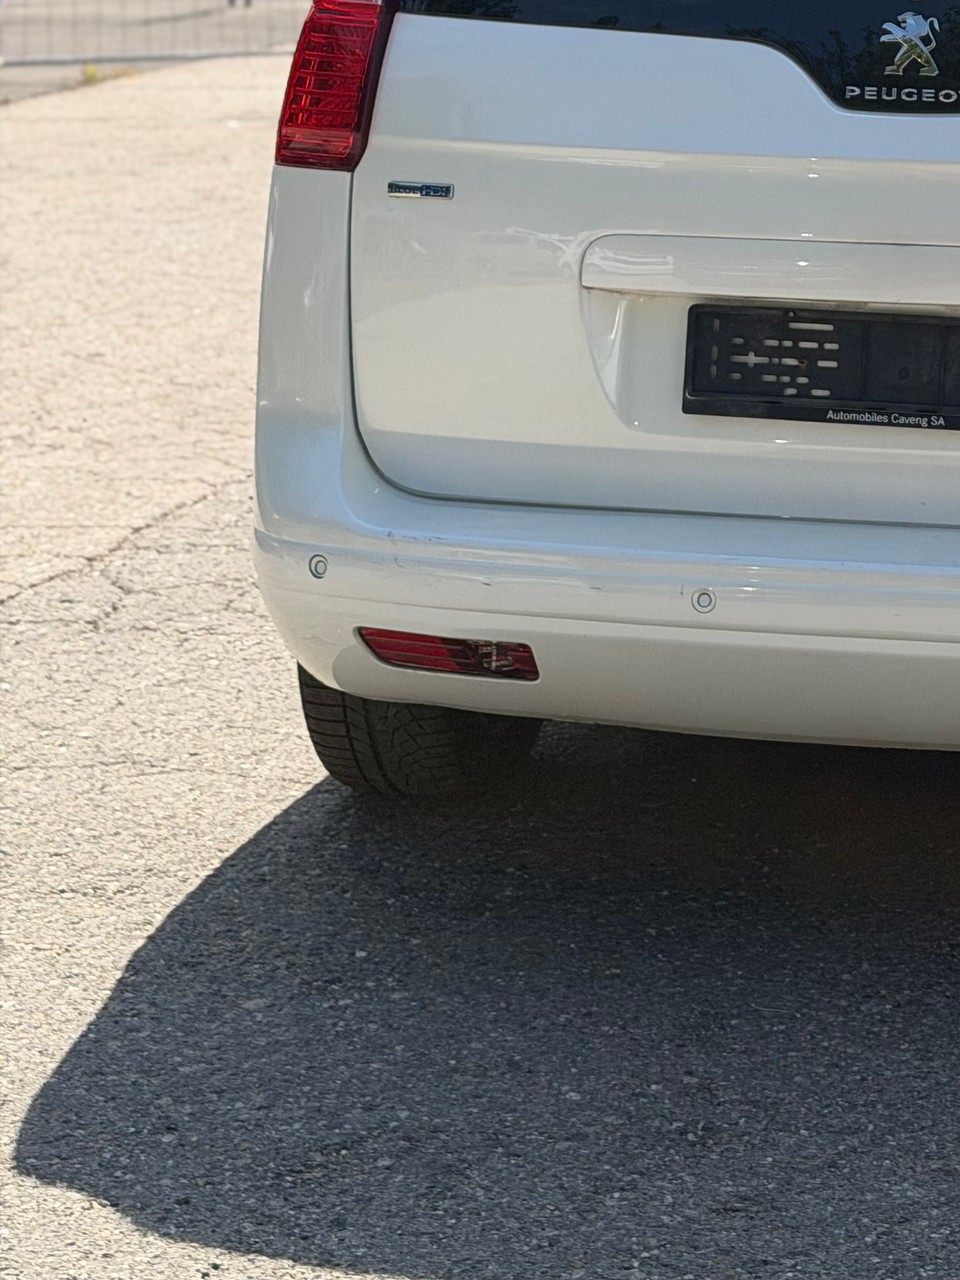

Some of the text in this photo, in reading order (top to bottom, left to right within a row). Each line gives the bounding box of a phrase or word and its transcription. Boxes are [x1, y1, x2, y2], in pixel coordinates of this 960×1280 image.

[826, 409, 945, 428] Automobiles Caveng SA
